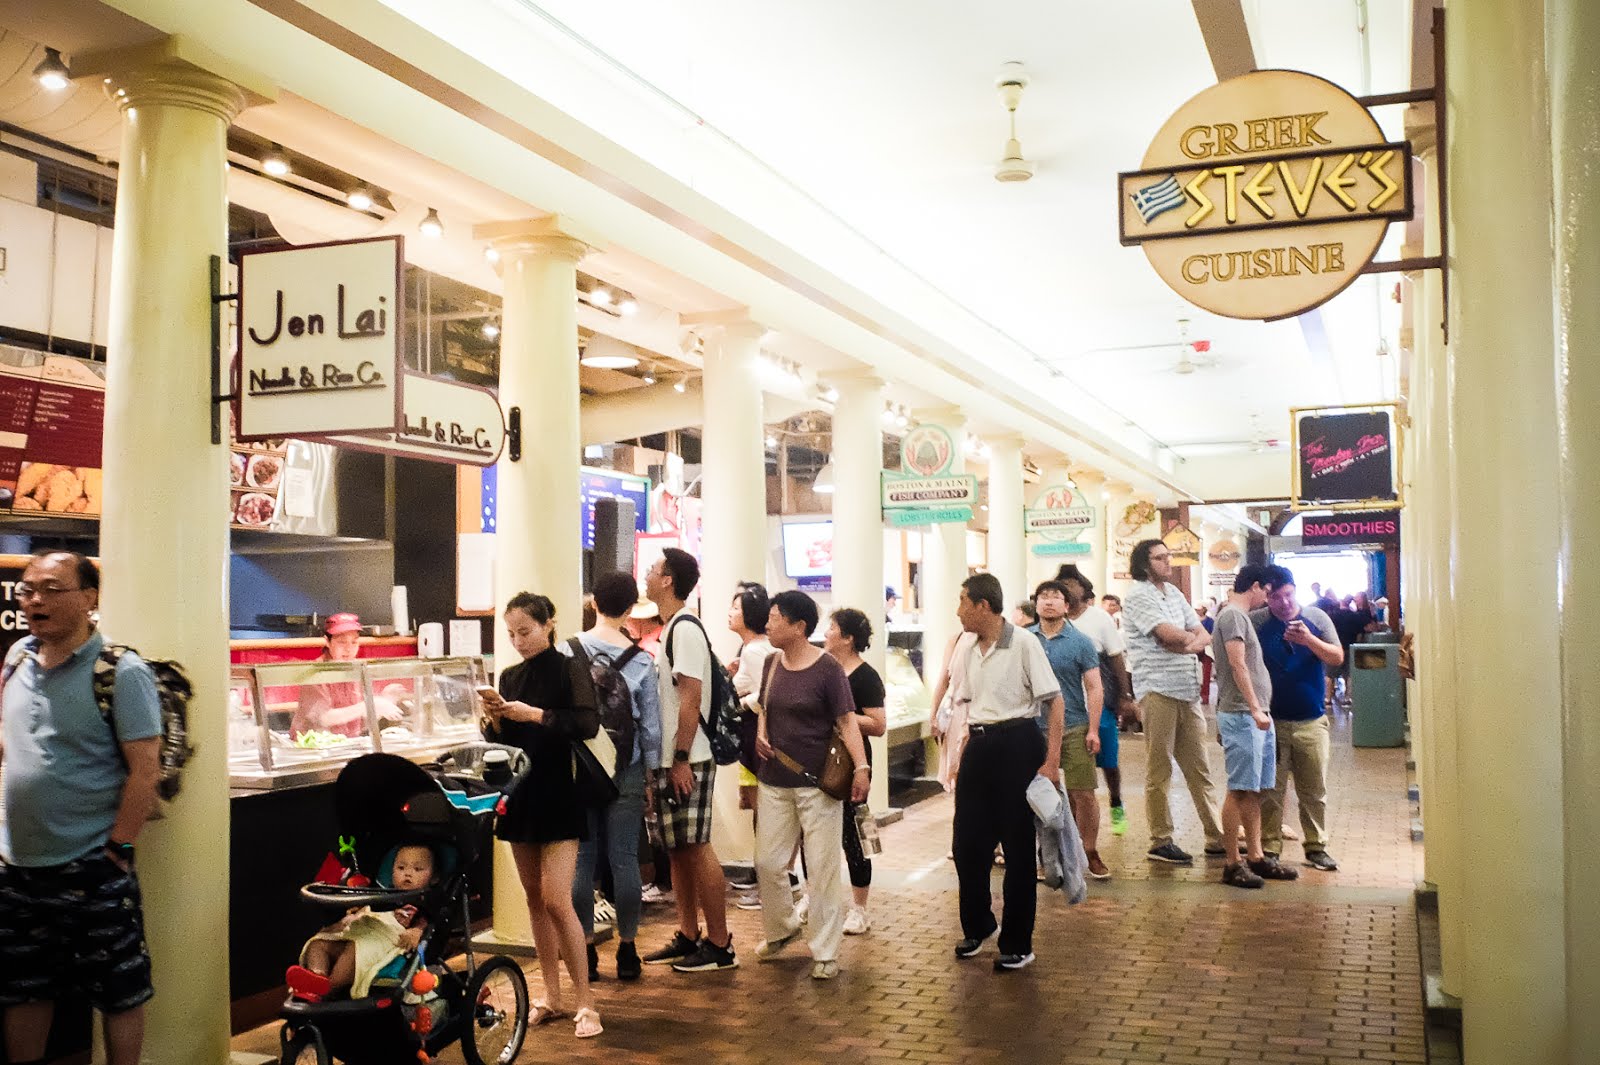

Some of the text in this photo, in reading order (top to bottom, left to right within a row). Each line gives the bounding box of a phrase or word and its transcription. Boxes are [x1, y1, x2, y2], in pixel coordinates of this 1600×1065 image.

[1179, 111, 1332, 160] GREEK
[1184, 150, 1399, 228] STEVE'S
[1181, 242, 1345, 285] CUISINE
[248, 284, 387, 345] Jen Lai
[299, 366, 318, 389] &
[434, 421, 447, 442] &
[887, 481, 924, 490] BOSTON
[935, 479, 971, 488] MAINE
[891, 489, 965, 501] FISH COMPANY
[1304, 521, 1396, 537] SMOOTHIES
